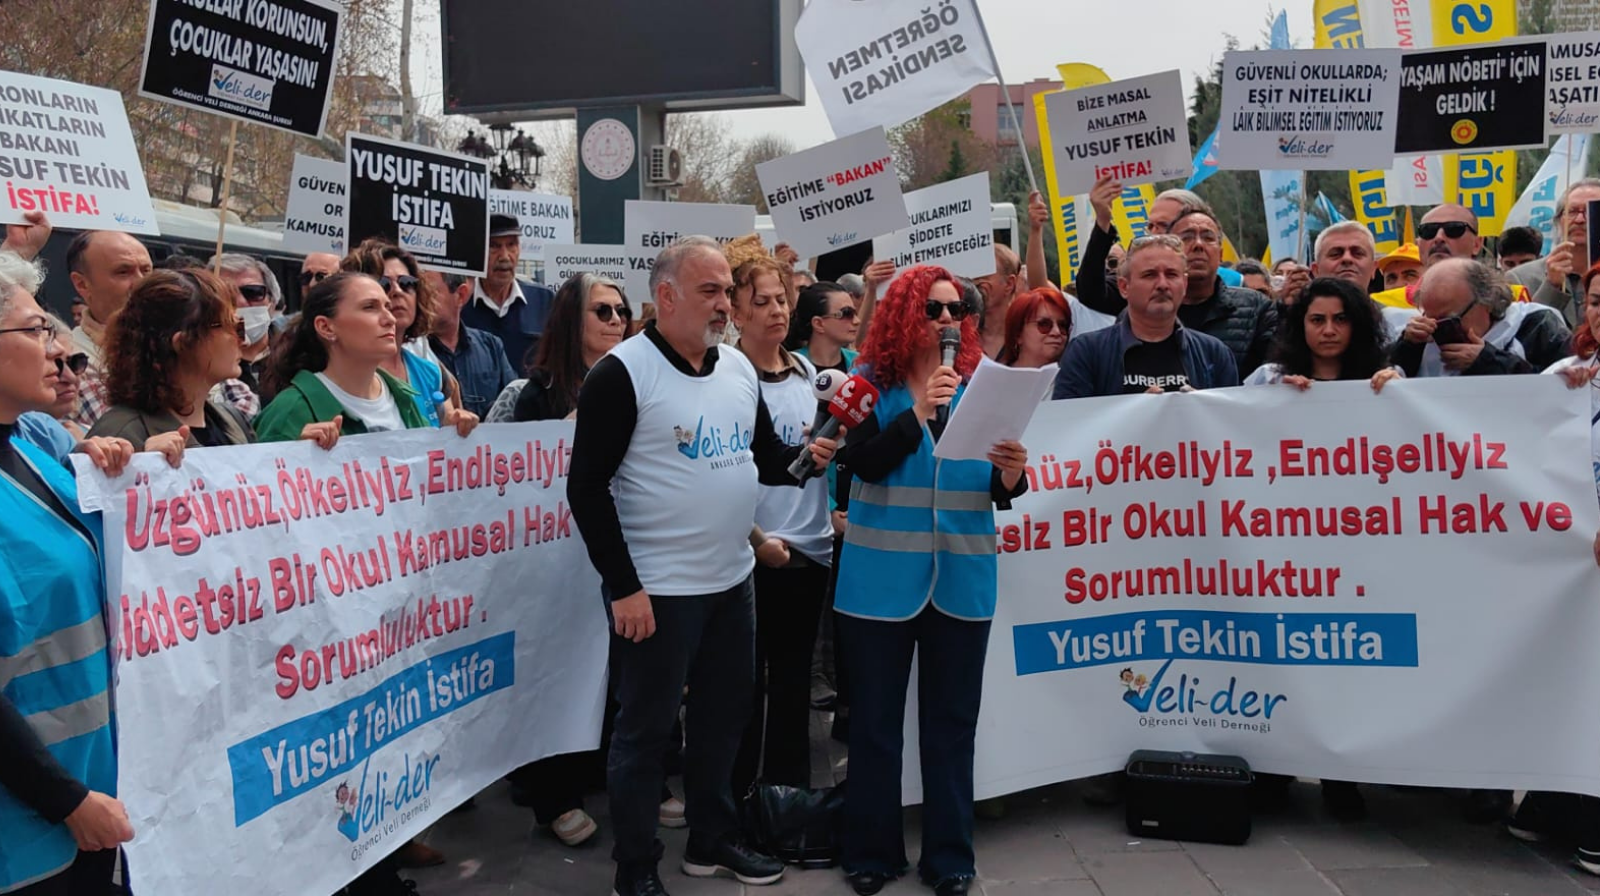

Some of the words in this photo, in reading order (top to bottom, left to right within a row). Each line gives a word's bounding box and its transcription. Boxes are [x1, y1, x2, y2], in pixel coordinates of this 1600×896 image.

[245, 0, 328, 54] KORUNSUN,
[170, 18, 250, 69] ÇOCUKLAR
[255, 44, 319, 89] YAŞASIN!
[1509, 50, 1540, 84] İÇİN
[1235, 61, 1296, 81] GÜVENLİ
[1300, 64, 1388, 82] OKULLARDA;
[1077, 95, 1105, 112] BİZE
[1107, 87, 1152, 106] MASAL
[1248, 84, 1284, 108] EŞİT
[1289, 83, 1372, 104] NİTELİKLİ
[1436, 86, 1487, 115] GELDİK
[1087, 110, 1148, 131] ANLATMA
[1256, 106, 1297, 131] BİLİMSEL
[1299, 106, 1332, 131] EĞİTİM
[1334, 106, 1384, 131] İSTİYORUZ
[0, 131, 80, 157] BAKANI
[1065, 138, 1121, 161] YUSUF
[1124, 125, 1176, 151] TEKİN
[52, 162, 130, 191] TEKİN
[352, 148, 424, 188] YUSUF
[429, 162, 486, 200] TEKİN
[1094, 160, 1153, 181] İSTİFA!
[6, 181, 100, 216] İSTİFA!
[392, 184, 455, 230] İSTİFA
[767, 179, 825, 208] EĞİTİME
[799, 187, 875, 222] İSTİYORUZ
[530, 201, 570, 220] BAKAN
[908, 199, 972, 226] UKLARIMIZI
[890, 252, 913, 268] LİM
[915, 233, 991, 264] ETMEYECEĞİZ!
[909, 223, 953, 248] ŞİDDETE
[555, 256, 625, 267] ÇOCUKLARIMIZ
[1123, 374, 1189, 387] URBERR
[1063, 507, 1112, 547] Bir
[1123, 500, 1206, 539] Okul
[1221, 496, 1402, 537] Kamusal
[1418, 493, 1508, 535] Hak
[1519, 500, 1573, 532] ve
[116, 567, 264, 662] iddetsiz
[269, 553, 318, 614] Bir
[321, 535, 392, 597] Okul
[393, 509, 515, 577] Kamusal
[524, 501, 572, 547] Hak
[1064, 558, 1341, 604] Sorumluluktur
[275, 594, 474, 699] Sorumluluktur
[1048, 618, 1146, 665] Yusuf
[1156, 618, 1261, 657] Tekin
[1276, 613, 1383, 660] İstifa
[262, 709, 358, 797] Yusuf
[363, 682, 421, 748] Tekin
[426, 652, 495, 712] İstifa
[1138, 715, 1188, 729] Öğrenci
[1192, 717, 1217, 728] Veli
[1220, 718, 1272, 734] Derneği
[351, 831, 383, 862] Öğrenci
[383, 821, 399, 838] Veli
[400, 797, 431, 825] Derneği
